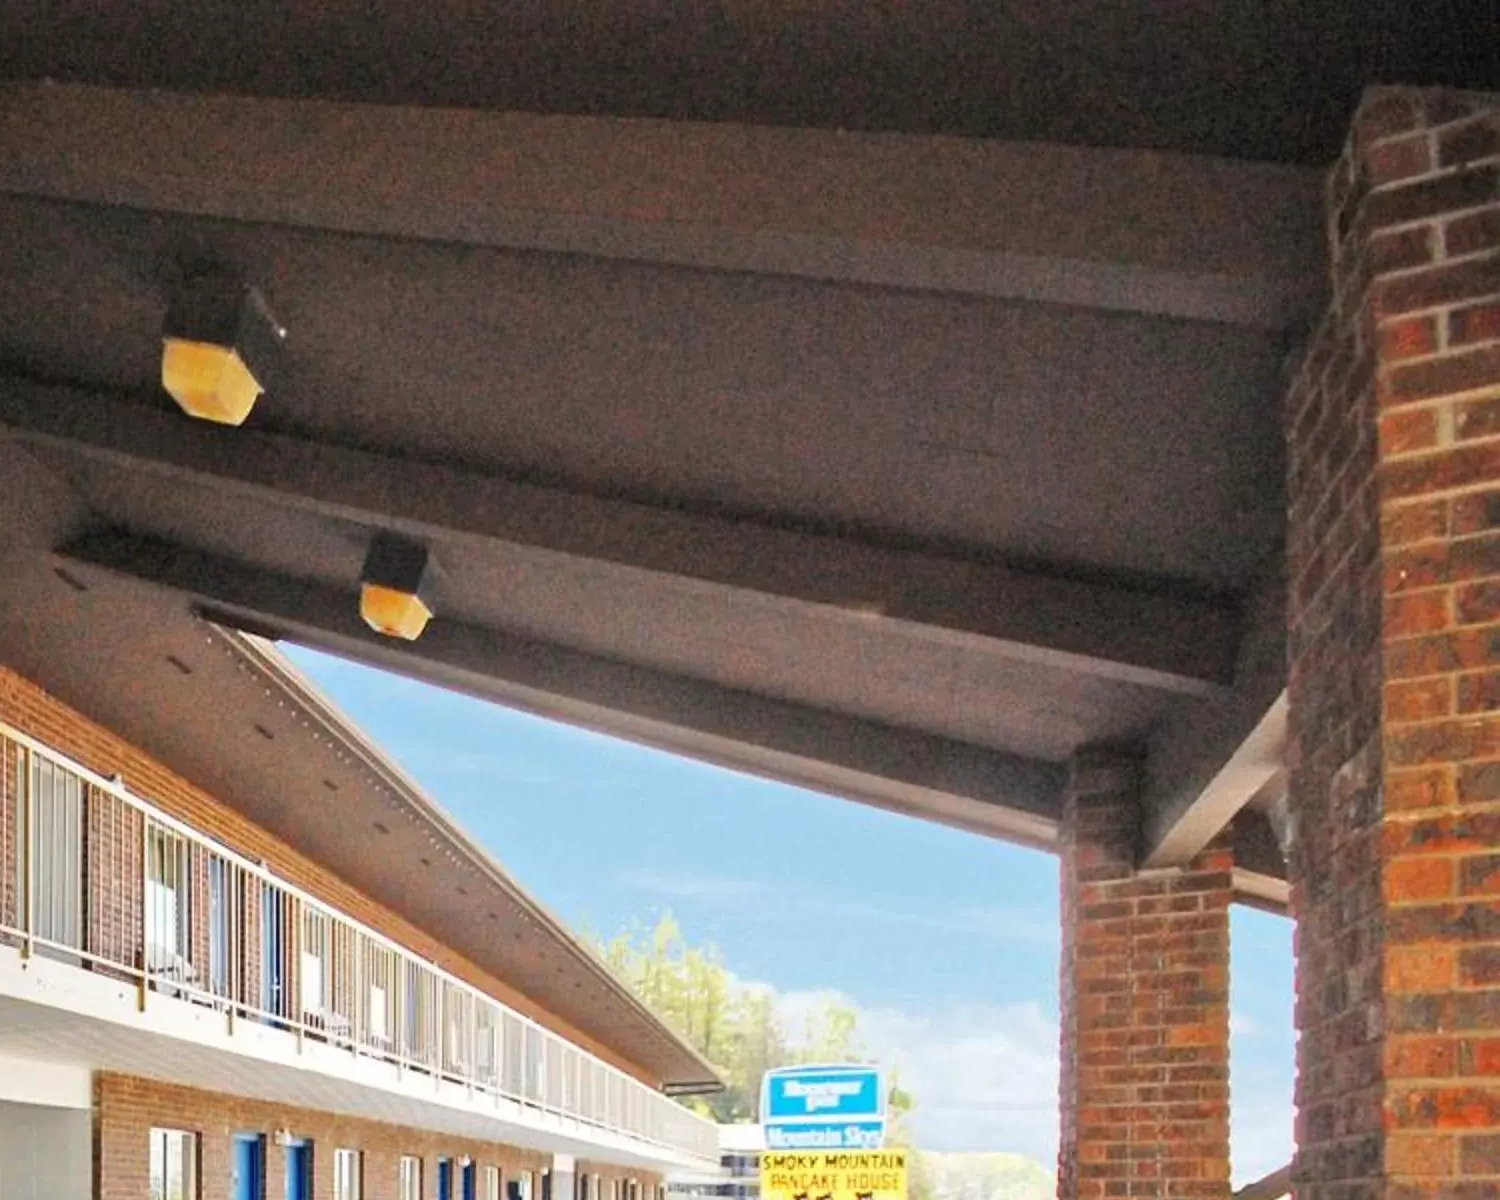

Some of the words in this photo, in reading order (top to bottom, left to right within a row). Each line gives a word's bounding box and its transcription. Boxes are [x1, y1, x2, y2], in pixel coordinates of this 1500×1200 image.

[763, 1154, 818, 1170] SMOKY
[825, 1154, 905, 1170] MOUNTAIN
[770, 1173, 838, 1189] PANCAKE
[846, 1173, 900, 1189] HOUSE
